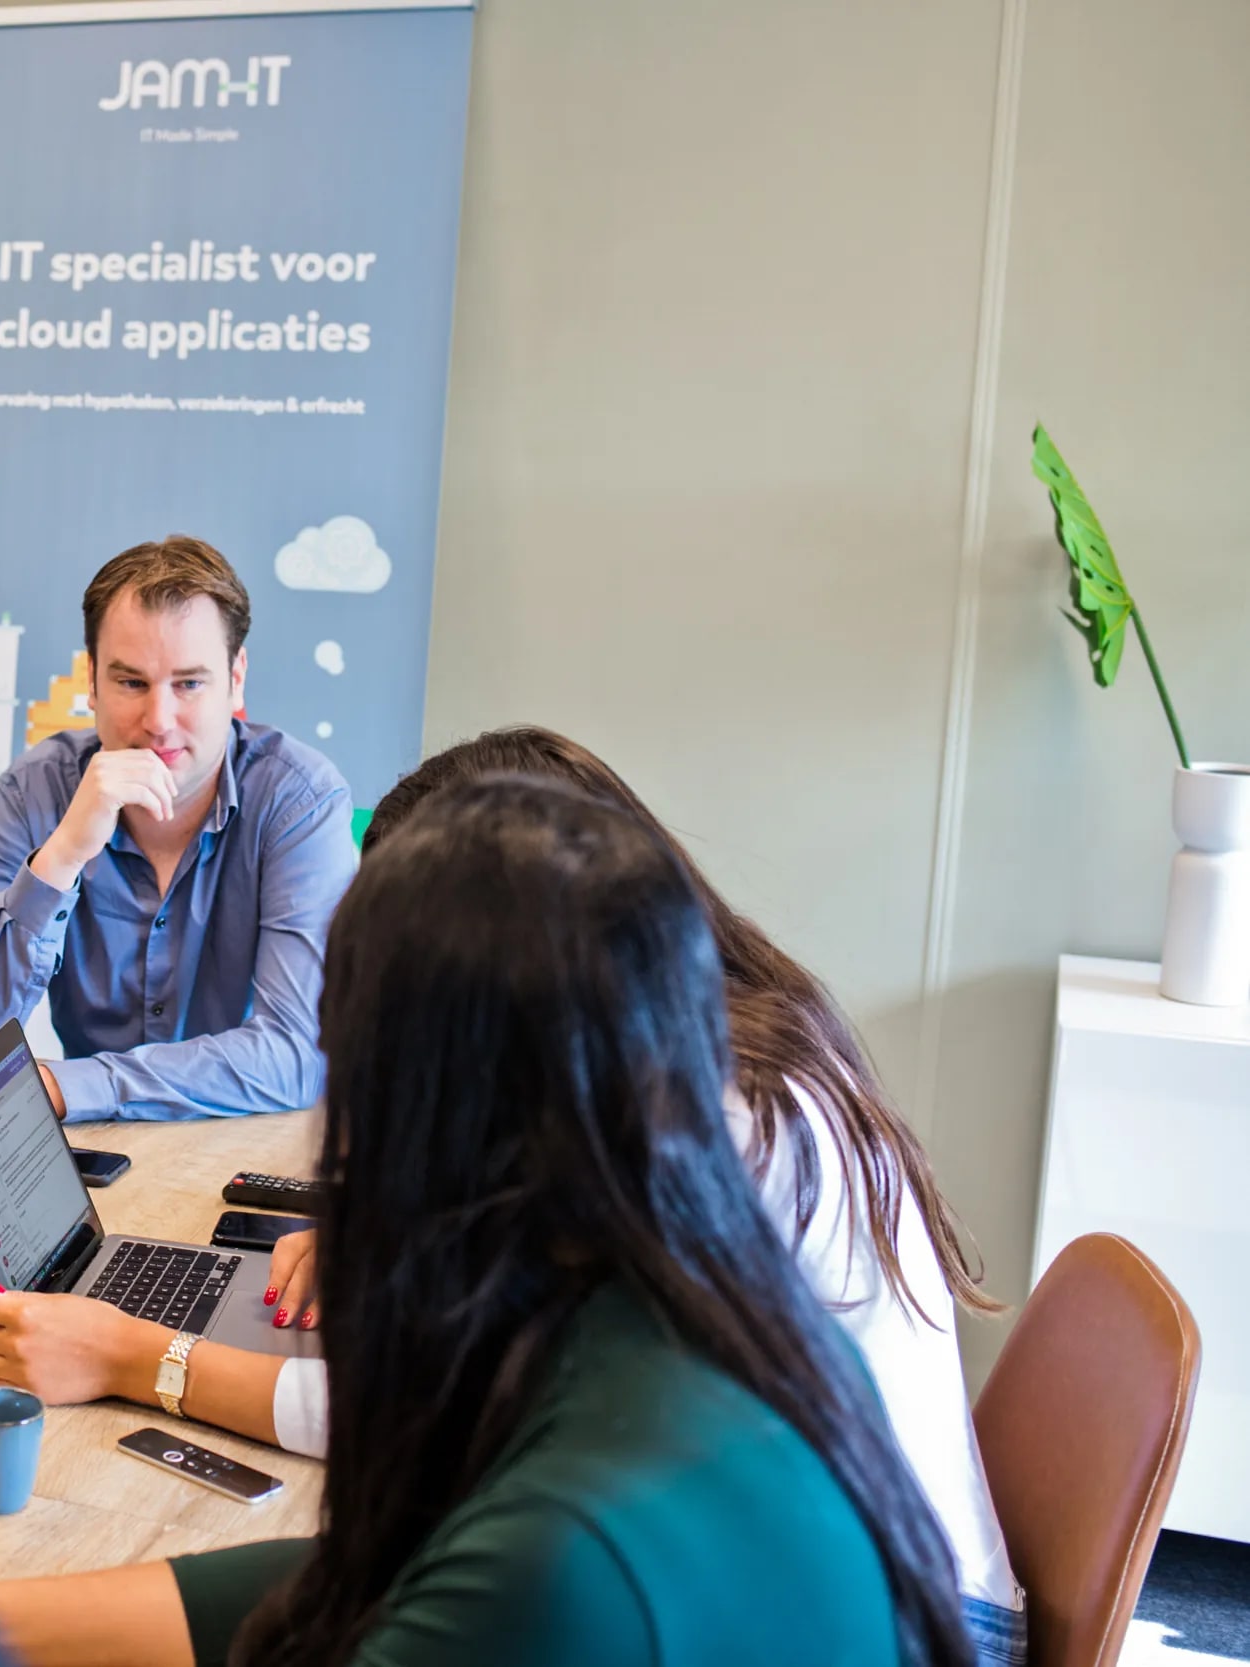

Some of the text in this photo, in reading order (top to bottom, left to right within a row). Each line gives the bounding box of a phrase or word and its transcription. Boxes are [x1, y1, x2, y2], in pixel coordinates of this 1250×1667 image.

[155, 129, 193, 142] Made
[195, 127, 239, 143] Simple
[0, 240, 377, 291] IT specialist voor
[121, 308, 371, 360] applicaties
[52, 394, 83, 408] met
[178, 395, 284, 415] verzekeringen
[286, 396, 299, 413] &
[301, 396, 366, 415] erfrecht
